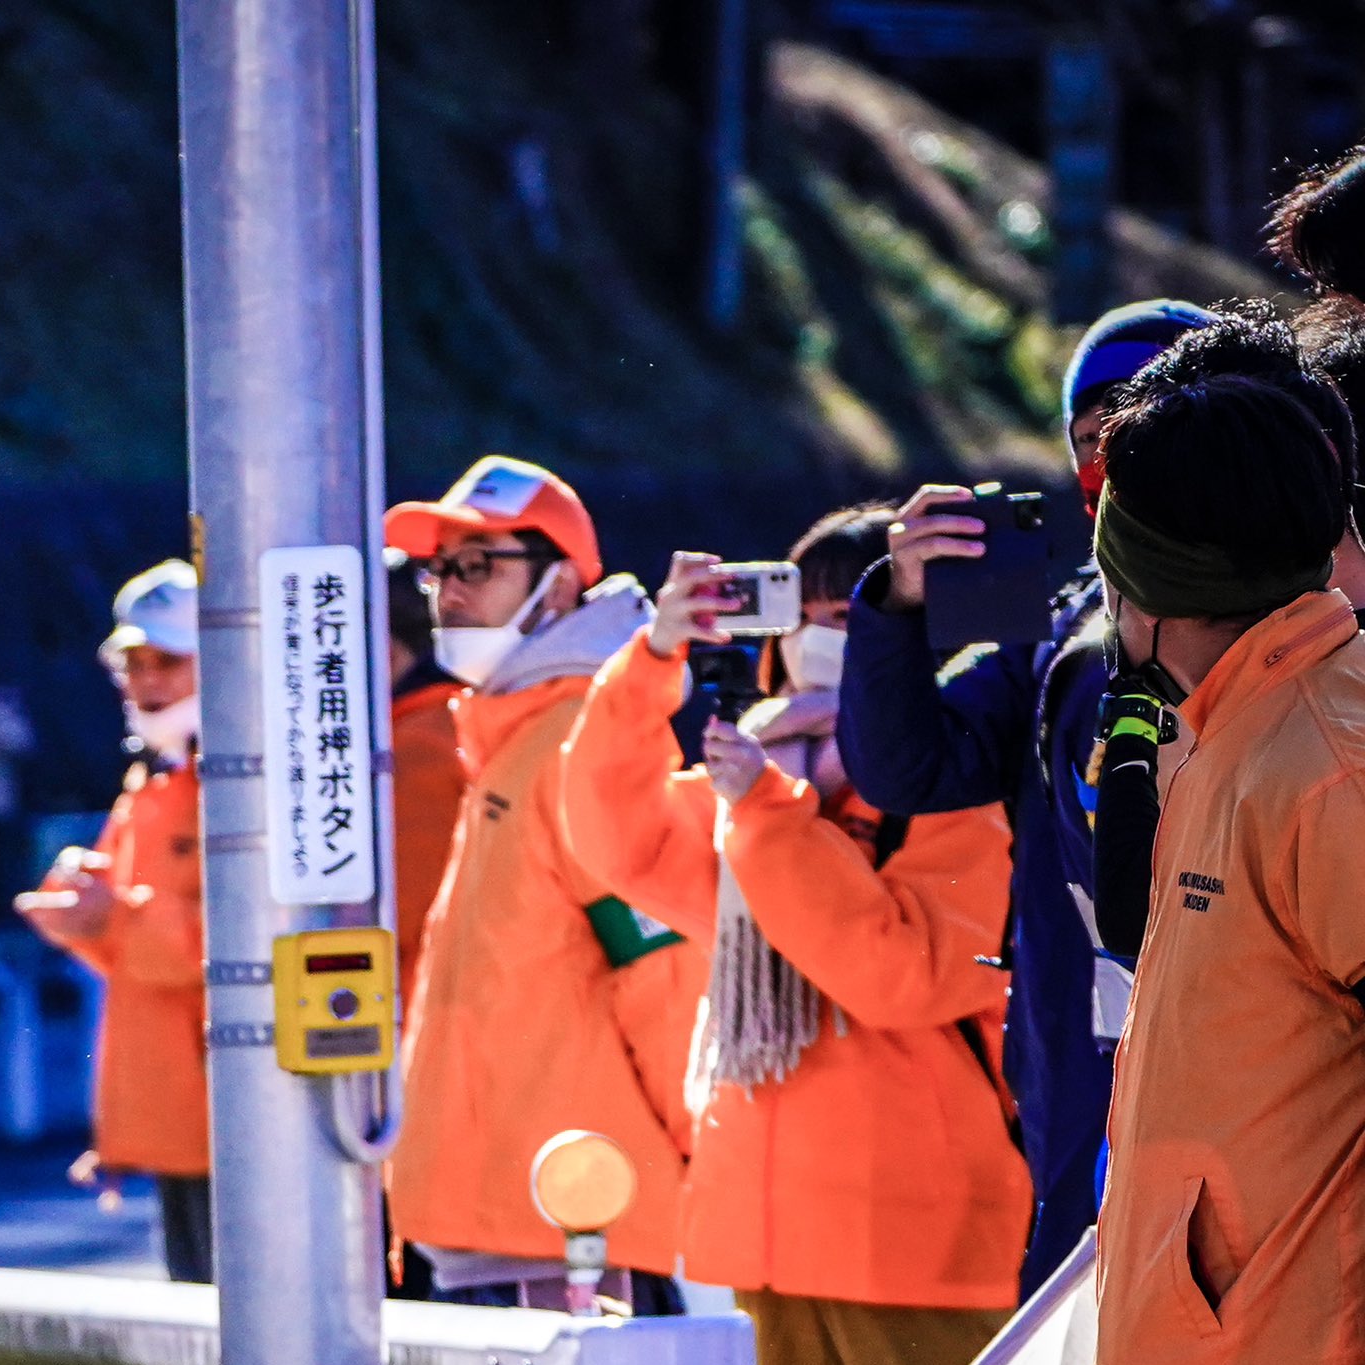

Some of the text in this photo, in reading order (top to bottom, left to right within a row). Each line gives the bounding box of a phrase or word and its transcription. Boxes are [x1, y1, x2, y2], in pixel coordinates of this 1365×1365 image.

[313, 572, 357, 876] 歩行者用押ボタン
